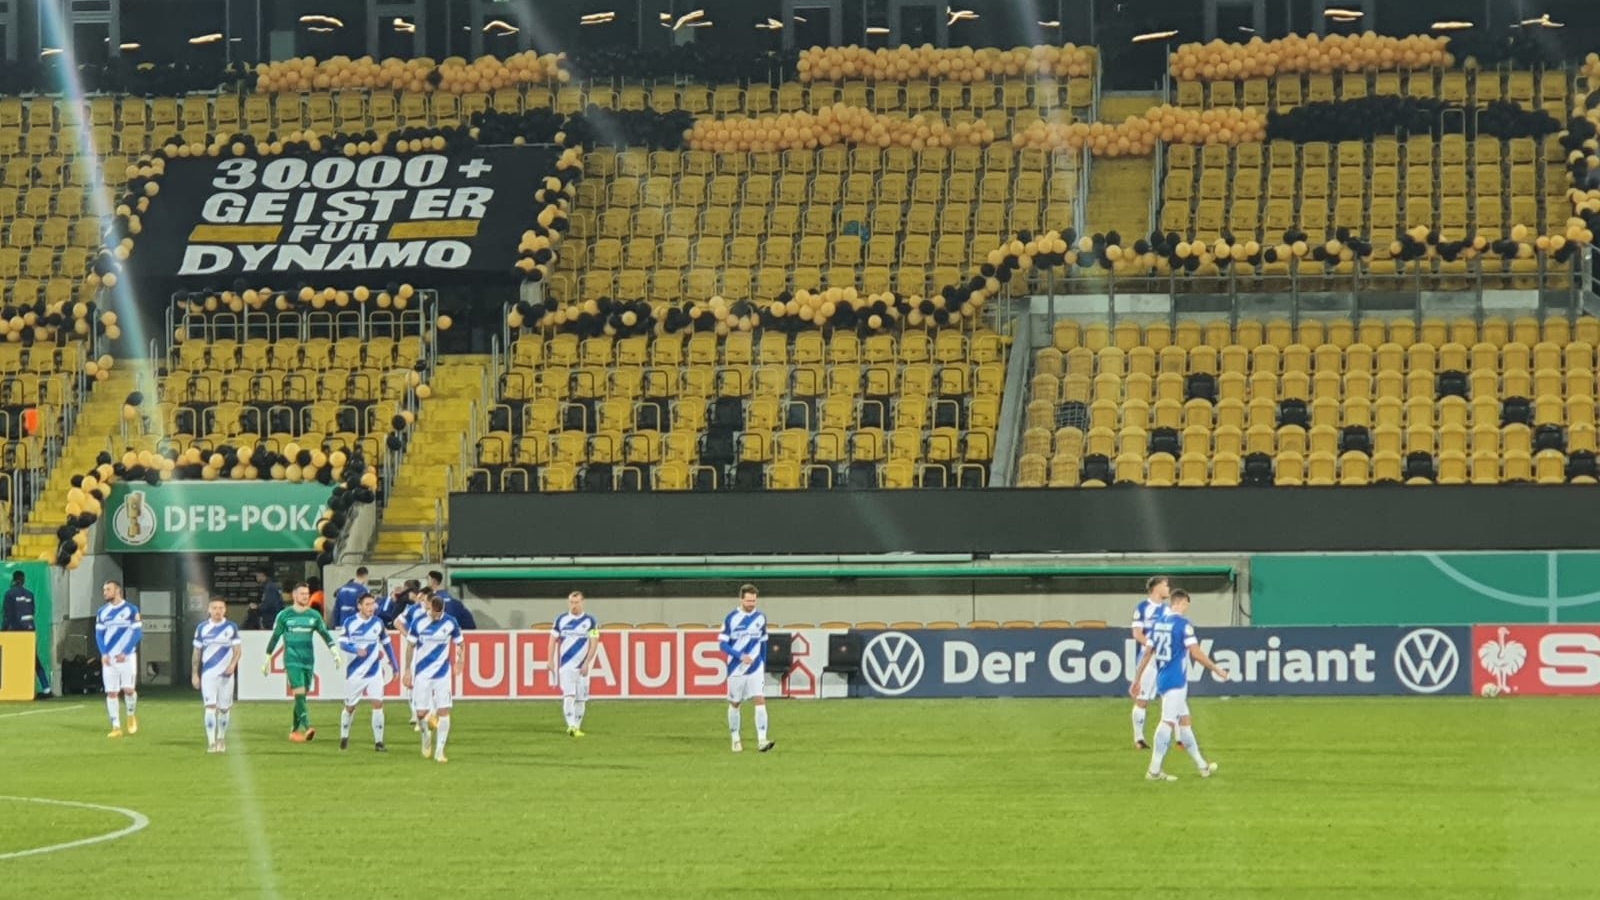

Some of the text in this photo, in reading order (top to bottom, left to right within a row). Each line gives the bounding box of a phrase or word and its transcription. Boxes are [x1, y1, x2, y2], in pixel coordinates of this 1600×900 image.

[212, 154, 449, 190] 30.000
[201, 187, 495, 224] GEISTER
[177, 240, 473, 276] DYNAMO
[943, 640, 1036, 684] Der
[1153, 631, 1173, 662] 23
